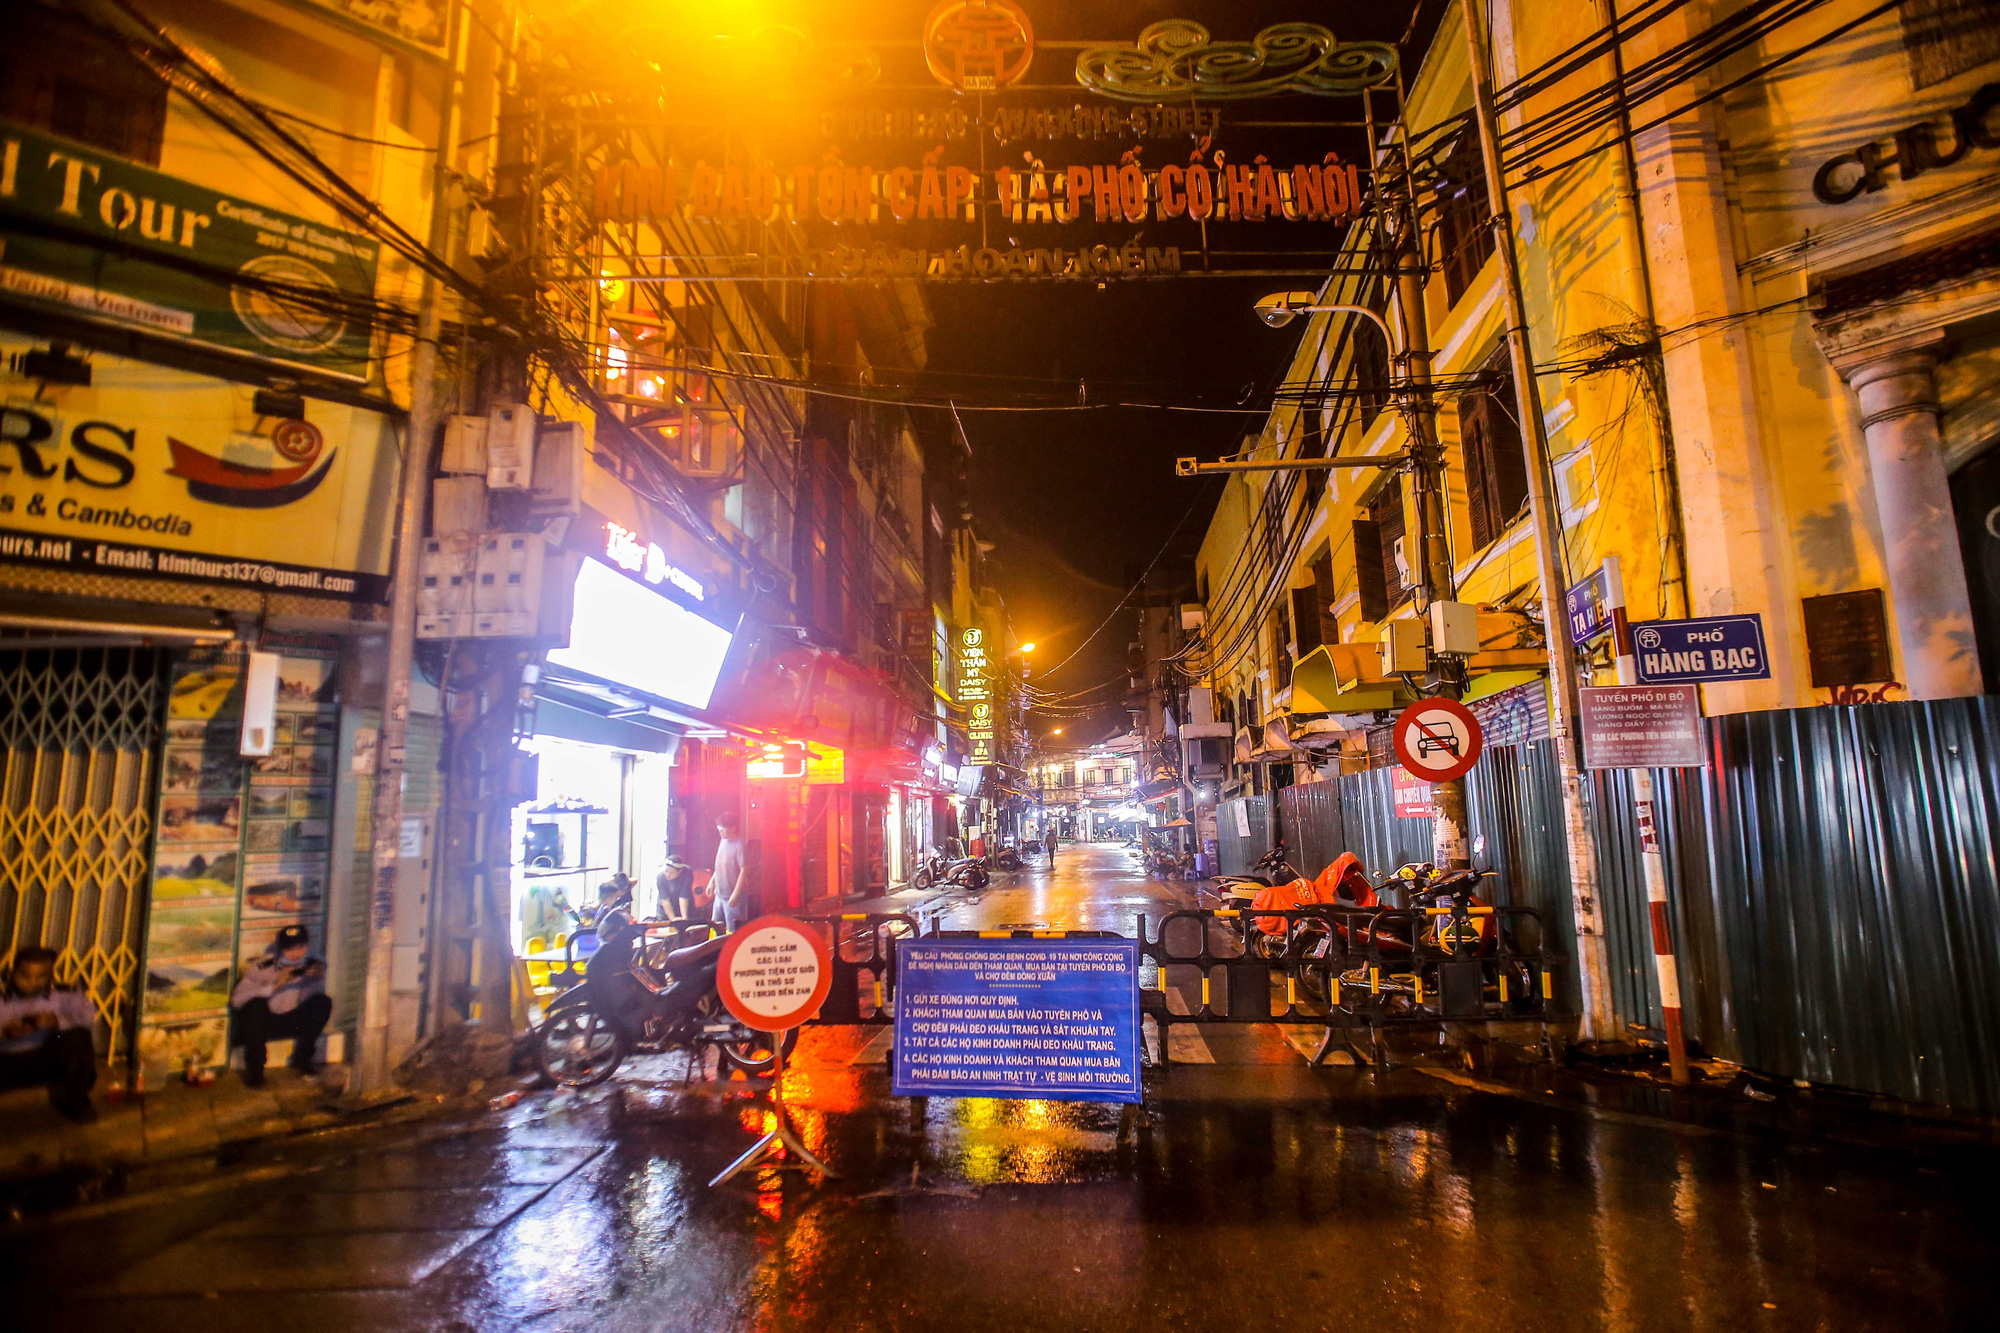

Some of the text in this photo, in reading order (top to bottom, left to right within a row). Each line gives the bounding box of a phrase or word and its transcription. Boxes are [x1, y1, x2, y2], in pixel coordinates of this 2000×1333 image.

[1131, 106, 1221, 137] STREET
[890, 145, 972, 219] CẤP
[1067, 145, 1145, 222] PHỐ
[1161, 135, 1212, 221] CỔ
[1226, 154, 1281, 221] HÀ
[1294, 152, 1361, 228] NỘI
[48, 152, 211, 248] Tour
[944, 237, 1062, 277] HOÀN
[27, 493, 191, 536] & Cambodia
[96, 544, 154, 569] Email:
[1584, 584, 1598, 602] PHỐ
[1573, 597, 1611, 635] TẠ HIỆN
[1687, 627, 1724, 643] PHỐ
[1644, 647, 1756, 674] HÀNG BẠC
[1595, 690, 1684, 703] TUYẾN PHỐ ĐI BỘ
[984, 962, 1002, 970] THAM
[1025, 963, 1040, 971] MUA
[906, 995, 911, 1004] 1.
[929, 995, 939, 1004] XE
[941, 993, 963, 1004] ĐÚNG
[965, 995, 978, 1005] NƠI
[980, 996, 997, 1005] QUY
[998, 996, 1019, 1007] ĐỊNH.
[905, 1008, 911, 1018] 2.
[913, 1007, 939, 1018] KHÁCH
[941, 1009, 963, 1018] THAM
[965, 1009, 986, 1019] QUAN
[989, 1010, 1006, 1019] MUA
[1008, 1008, 1024, 1019] BÁN
[1026, 1008, 1043, 1019] VÀO
[1091, 1009, 1102, 1020] VÀ
[912, 1023, 930, 1035] CHỢ
[970, 1024, 986, 1034] ĐEO
[1012, 1025, 1039, 1034] TRANG
[1040, 1023, 1052, 1035] VÀ
[1053, 1023, 1069, 1035] SÁT
[1100, 1026, 1116, 1036] TAY.
[904, 1037, 910, 1046] 3.
[941, 1036, 957, 1048] CÁC
[959, 1038, 971, 1050] HỘ
[973, 1038, 991, 1048] KINH
[993, 1039, 1021, 1049] DOANH
[1043, 1040, 1060, 1049] ĐEO
[1086, 1041, 1116, 1051] TRANG.
[904, 1052, 1120, 1067] 4. CÁC HỘ KINH DOANH VÀ KHÁCH THAM QUAN MUA BÁN
[969, 1070, 981, 1080] AN
[982, 1071, 1001, 1080] NINH
[1045, 1072, 1055, 1084] VỆ
[1058, 1073, 1076, 1082] SINH
[1078, 1071, 1093, 1082] MÔI
